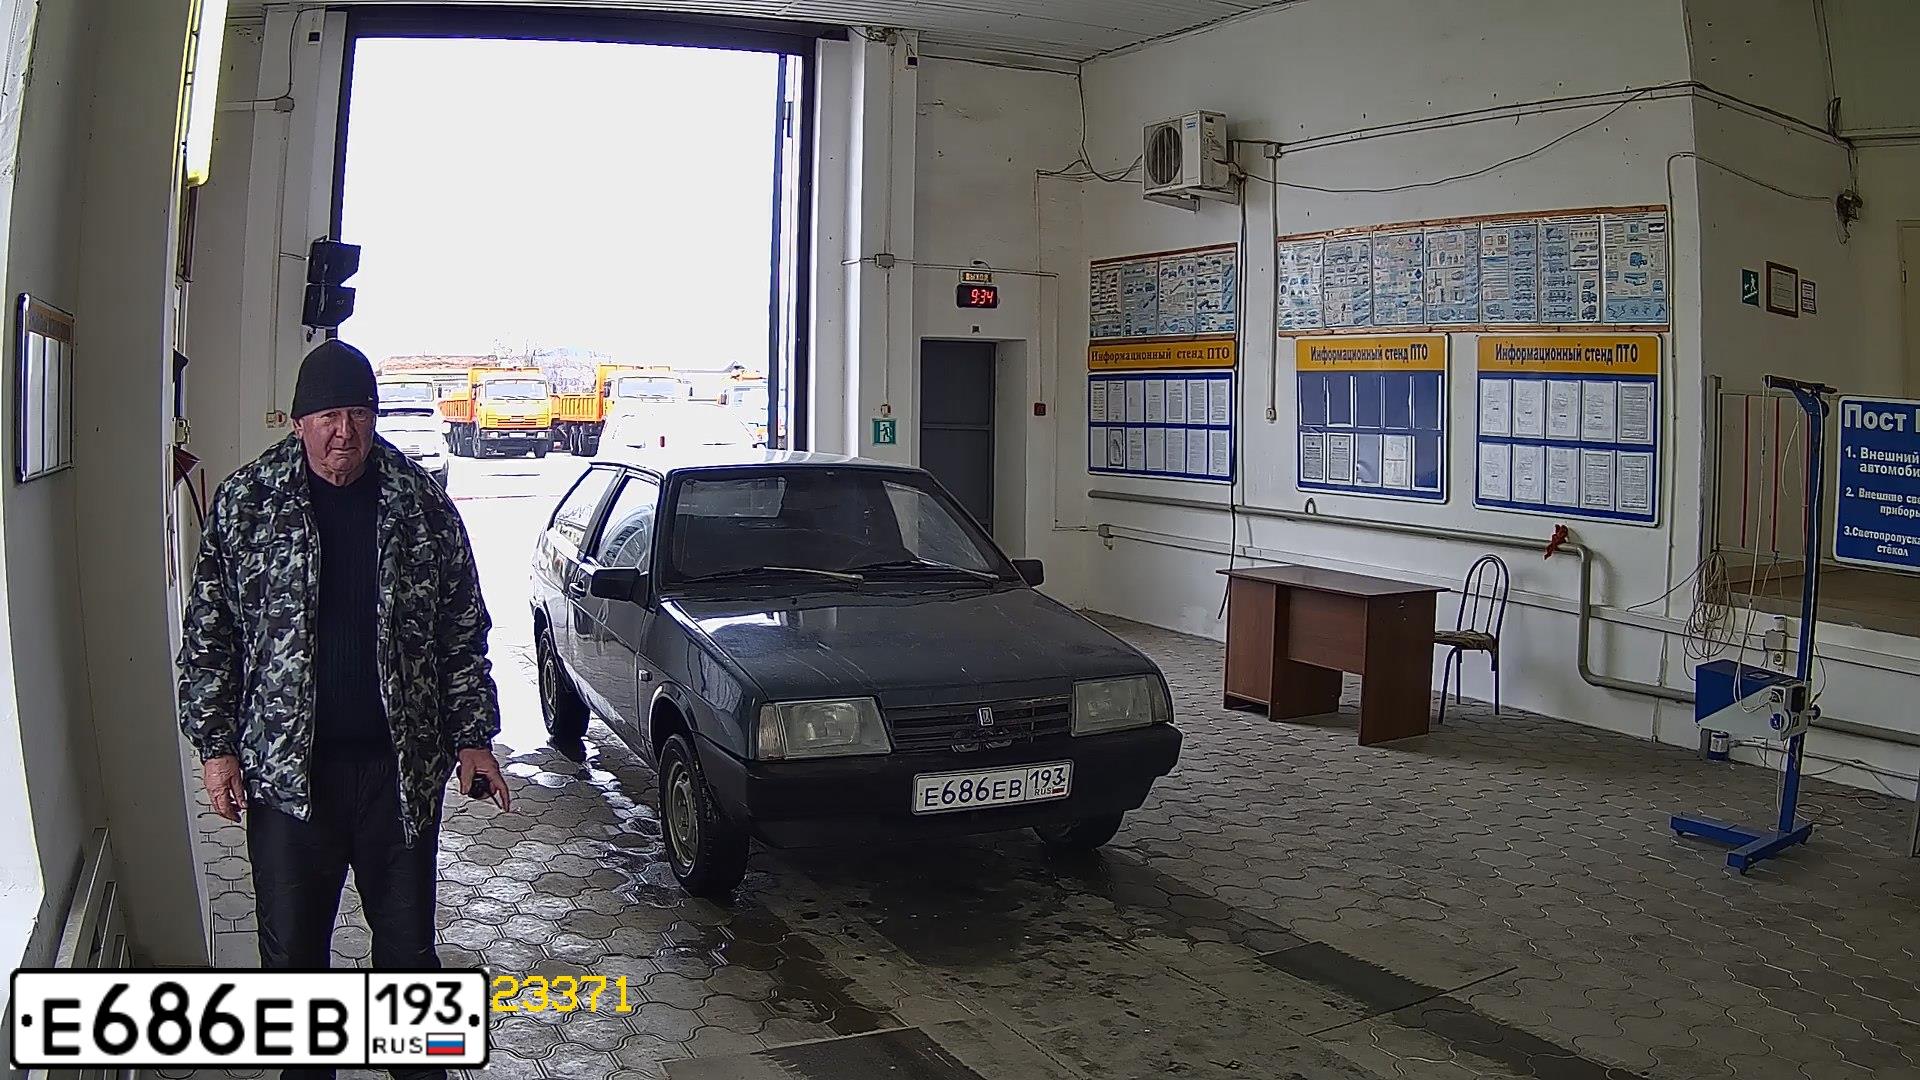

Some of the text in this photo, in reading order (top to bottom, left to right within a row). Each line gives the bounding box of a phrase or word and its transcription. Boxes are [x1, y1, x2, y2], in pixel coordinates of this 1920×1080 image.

[971, 288, 993, 304] 9:34
[1091, 347, 1230, 364] Информационный стенд ПТО
[1311, 344, 1428, 365] Информационный стенд ПТО
[1496, 343, 1638, 365] Информационный стенд ПТО
[1844, 403, 1907, 432] Пост
[1845, 445, 1920, 464] 1. Внешний
[1858, 487, 1903, 503] Внешние
[1029, 767, 1065, 788] 193
[1034, 786, 1051, 796] RUS
